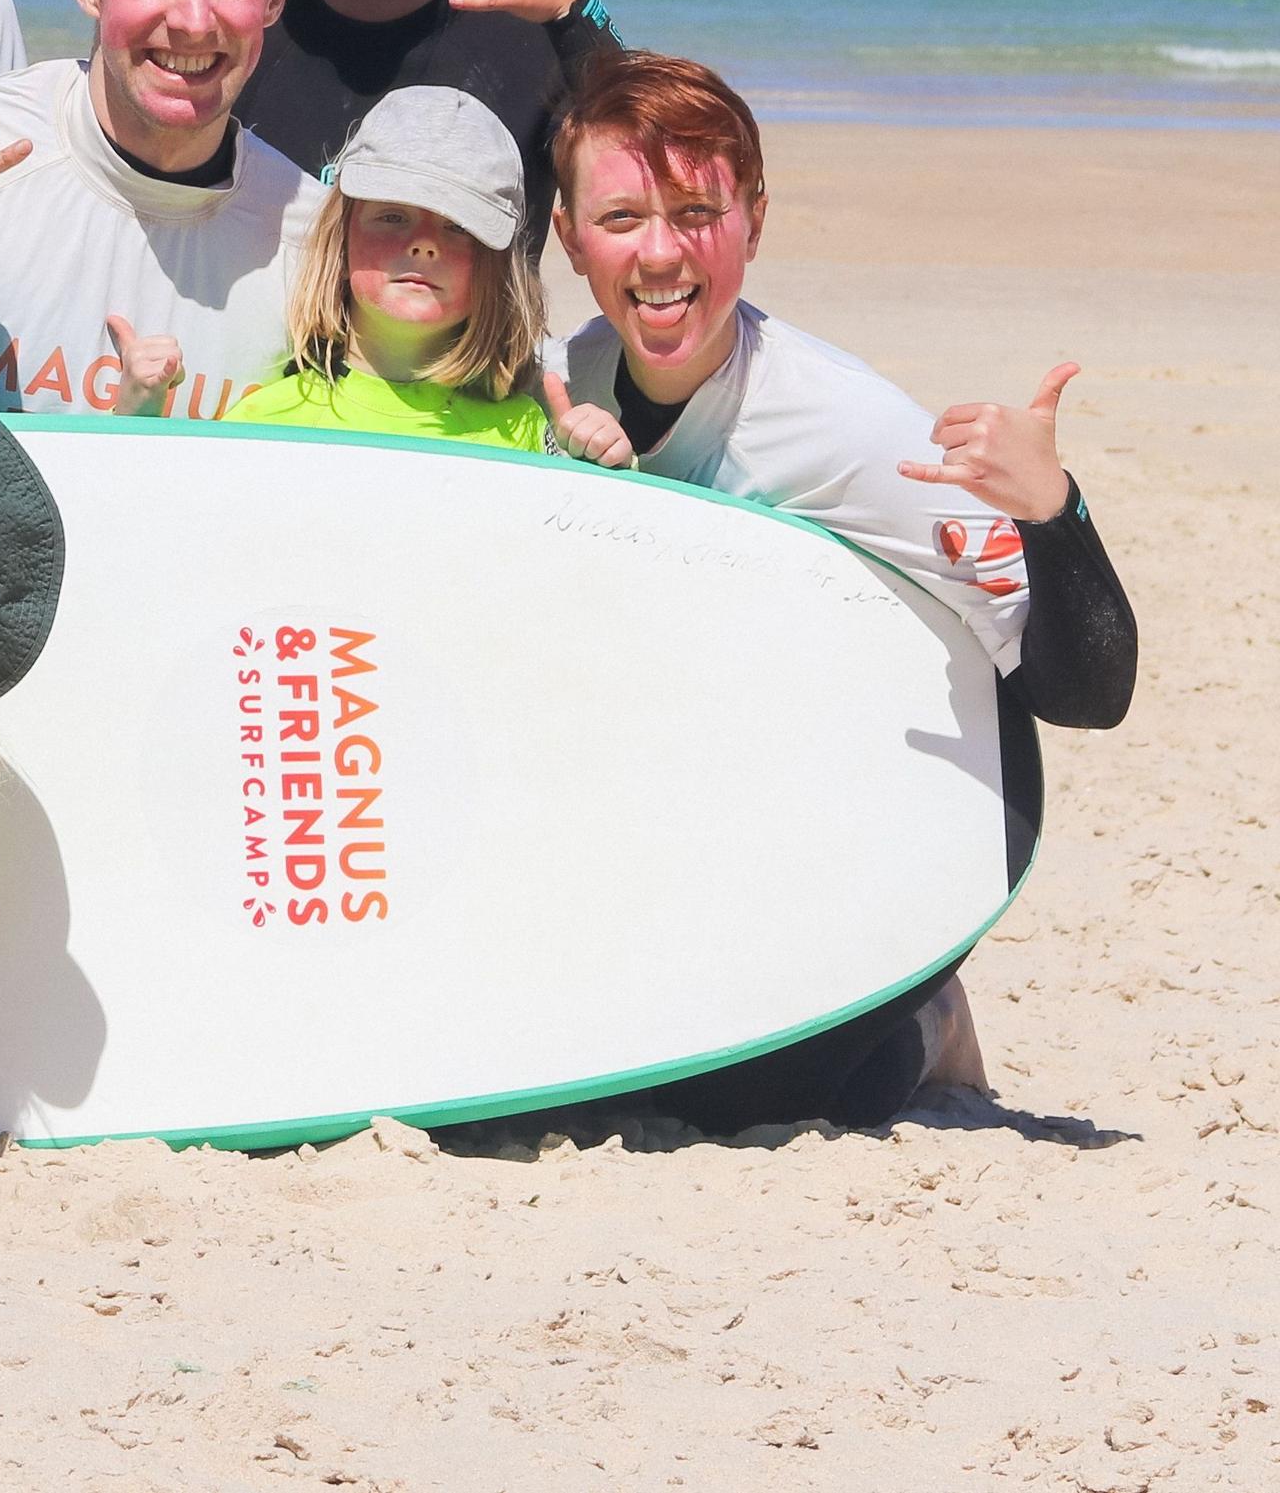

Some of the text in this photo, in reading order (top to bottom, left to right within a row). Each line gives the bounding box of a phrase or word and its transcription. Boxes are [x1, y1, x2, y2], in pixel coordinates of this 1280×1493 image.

[238, 668, 270, 888] SURFCAMP
[274, 625, 329, 926] & FRIENDS
[328, 626, 389, 923] MAGNUS
